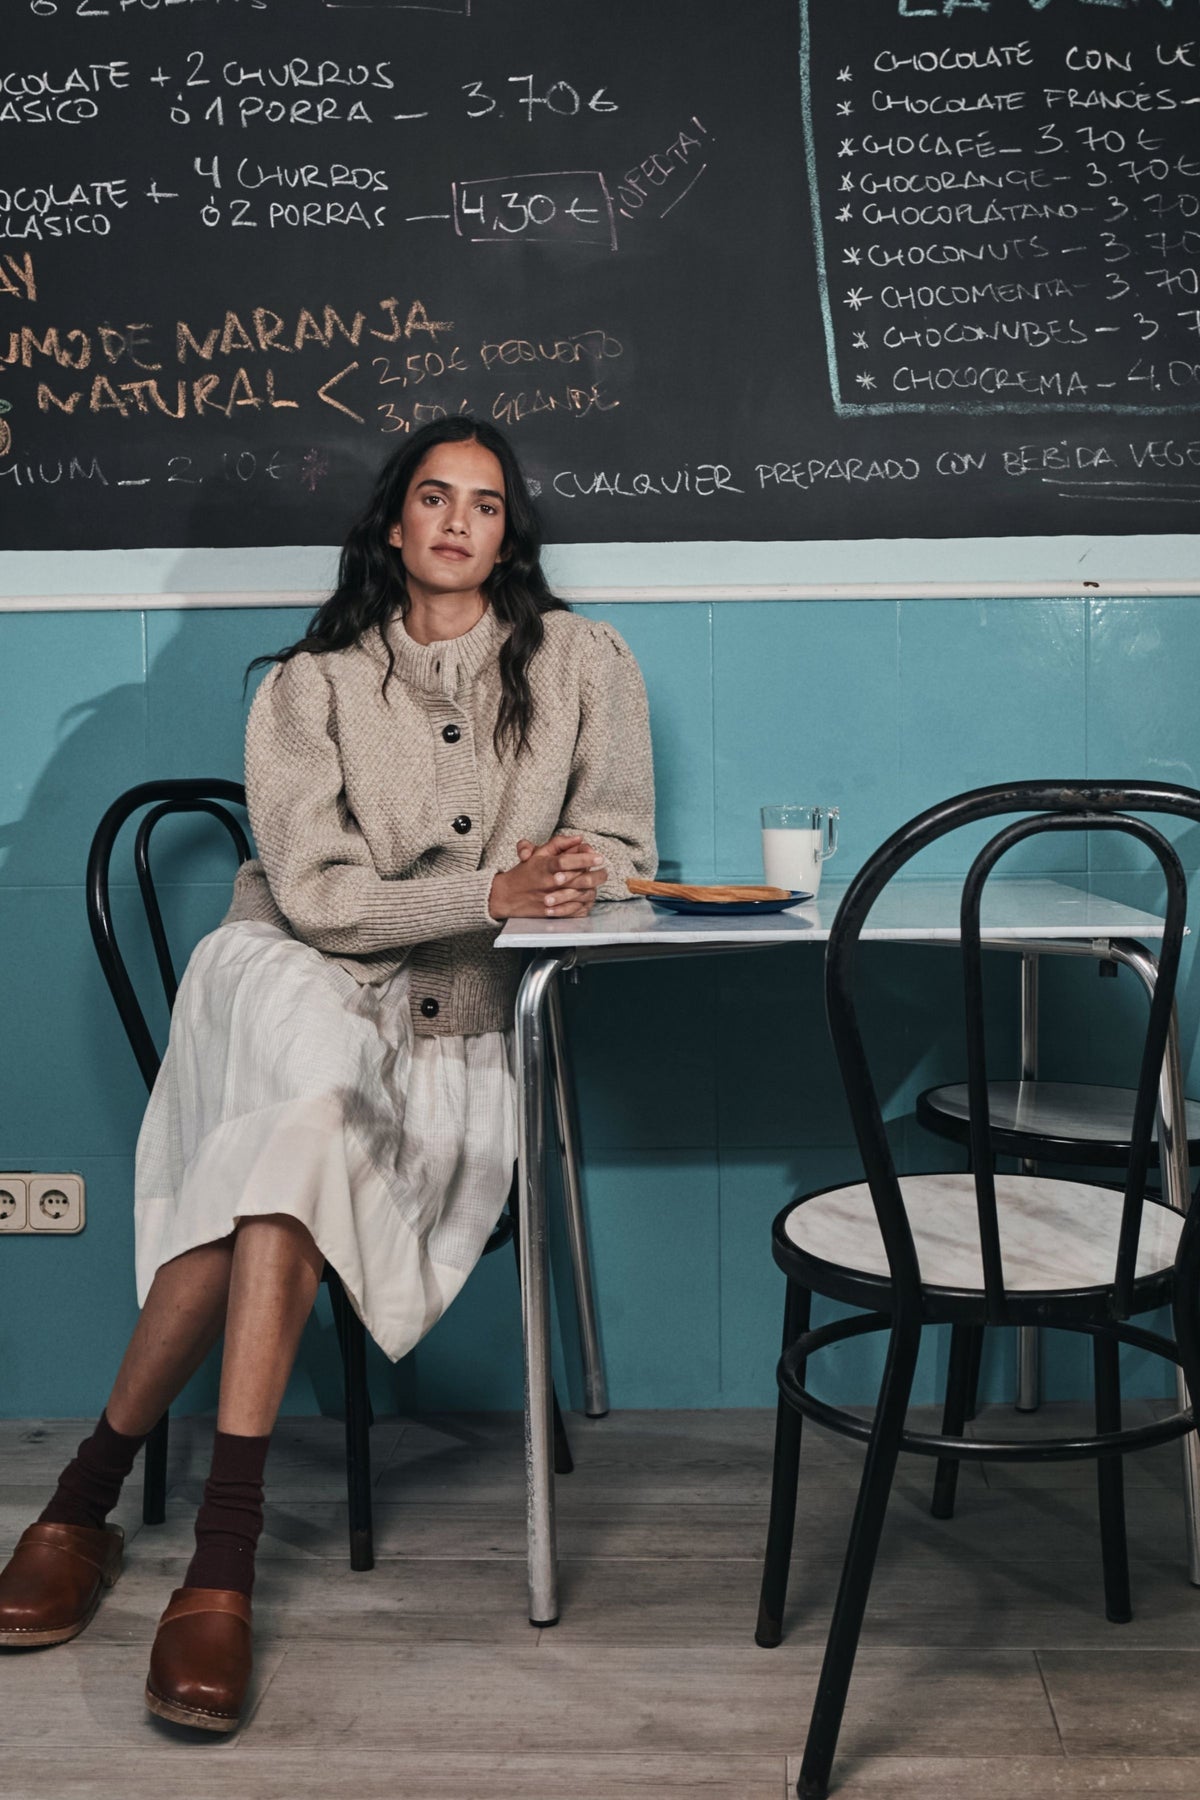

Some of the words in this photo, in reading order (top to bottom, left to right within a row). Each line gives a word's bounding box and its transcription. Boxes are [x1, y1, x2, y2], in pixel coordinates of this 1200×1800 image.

[0, 61, 130, 96] COLATE
[186, 51, 210, 86] 2
[222, 58, 394, 89] CHURROS
[1065, 45, 1132, 72] CON
[205, 96, 224, 126] 1
[239, 97, 373, 128] PORRA
[871, 90, 1026, 115] CHOCOLATE
[194, 155, 221, 189] 4
[237, 157, 389, 192] CHURROS
[859, 169, 1053, 193] CHOCORANGE
[230, 201, 257, 228] 2
[269, 202, 386, 230] PORRAS
[868, 235, 1049, 267] CHOCONUTS
[880, 279, 1073, 309] CHOCOMENTA
[177, 297, 455, 365] NARANJA
[882, 320, 1088, 348] CHOCONUBES
[38, 367, 299, 419] NATURAL
[553, 463, 744, 497] CUALQUIER
[755, 457, 920, 489] PREPARADO
[936, 451, 987, 476] CON
